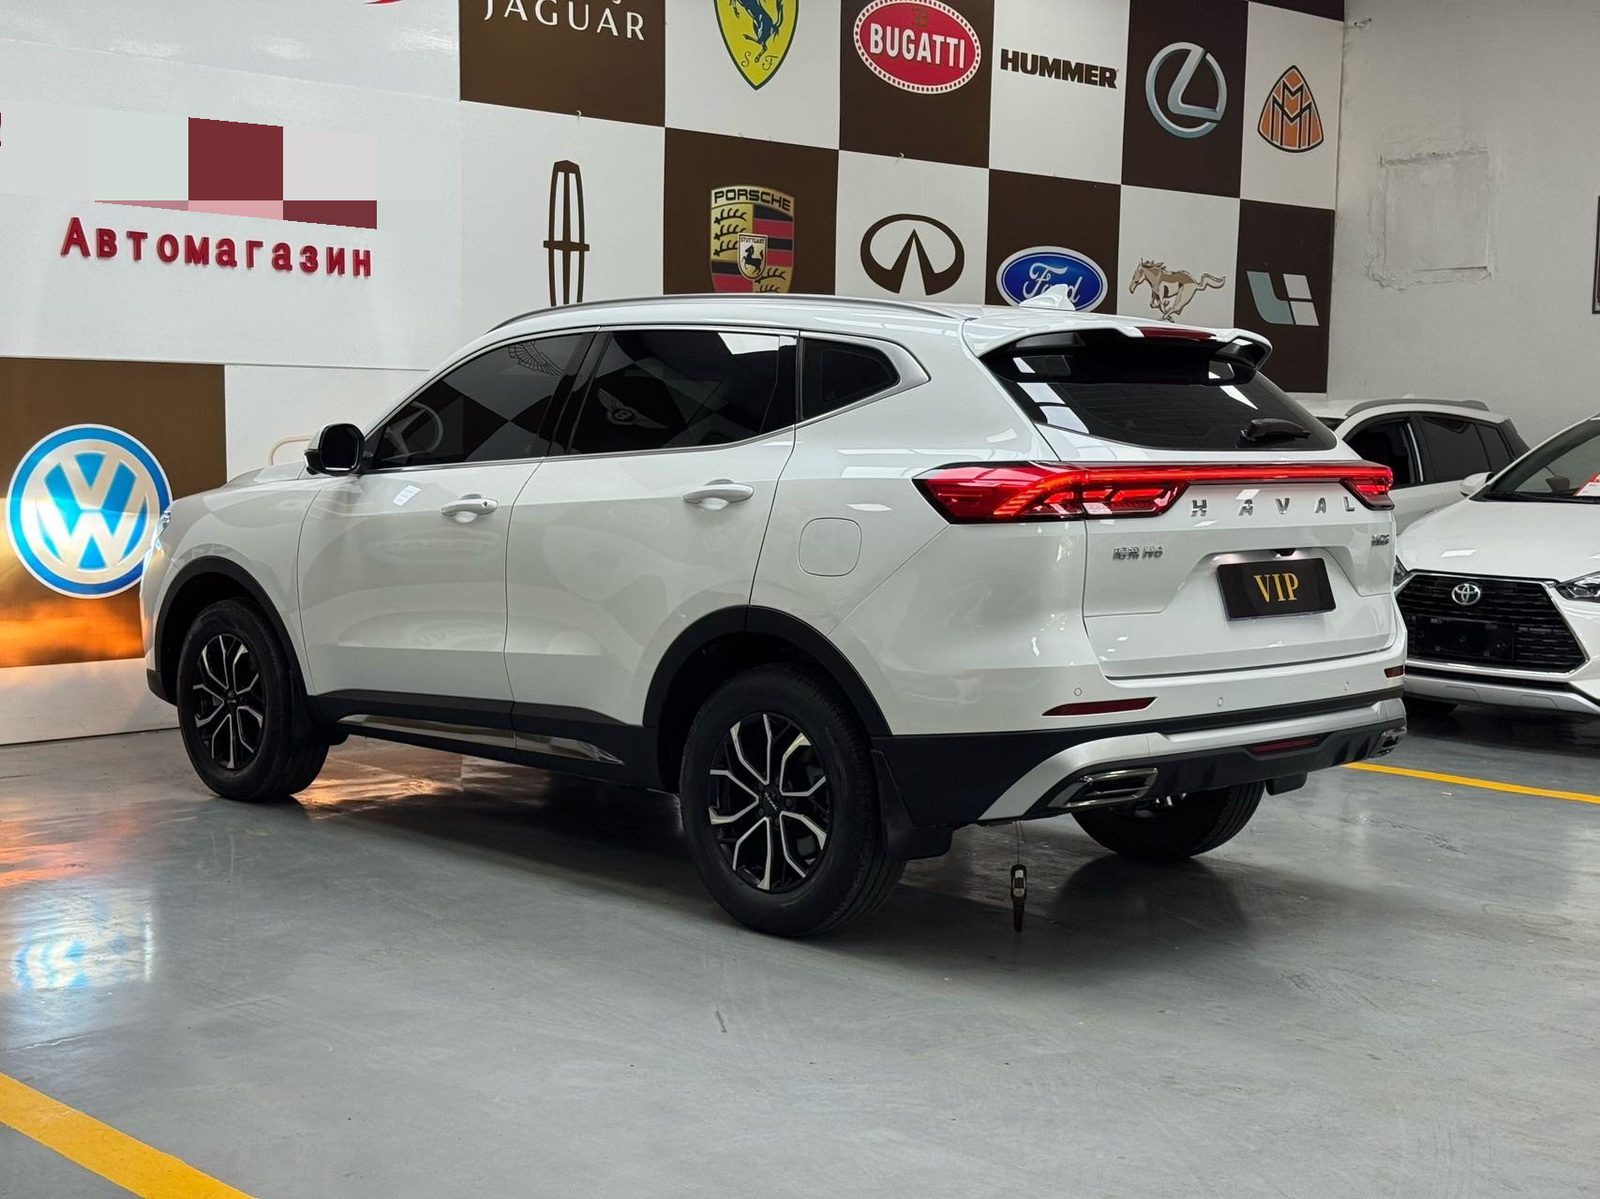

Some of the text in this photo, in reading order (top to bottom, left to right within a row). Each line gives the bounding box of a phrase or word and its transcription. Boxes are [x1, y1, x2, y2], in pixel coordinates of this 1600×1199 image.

[484, 0, 645, 41] JAGUAR
[869, 23, 966, 69] BUGATTI
[1000, 48, 1118, 89] HUMMER
[714, 188, 791, 212] PORSCHE
[60, 216, 372, 277] Автомагазин
[1022, 262, 1084, 303] Fd
[1191, 497, 1356, 516] HAVAL
[1253, 572, 1299, 603] VIP
